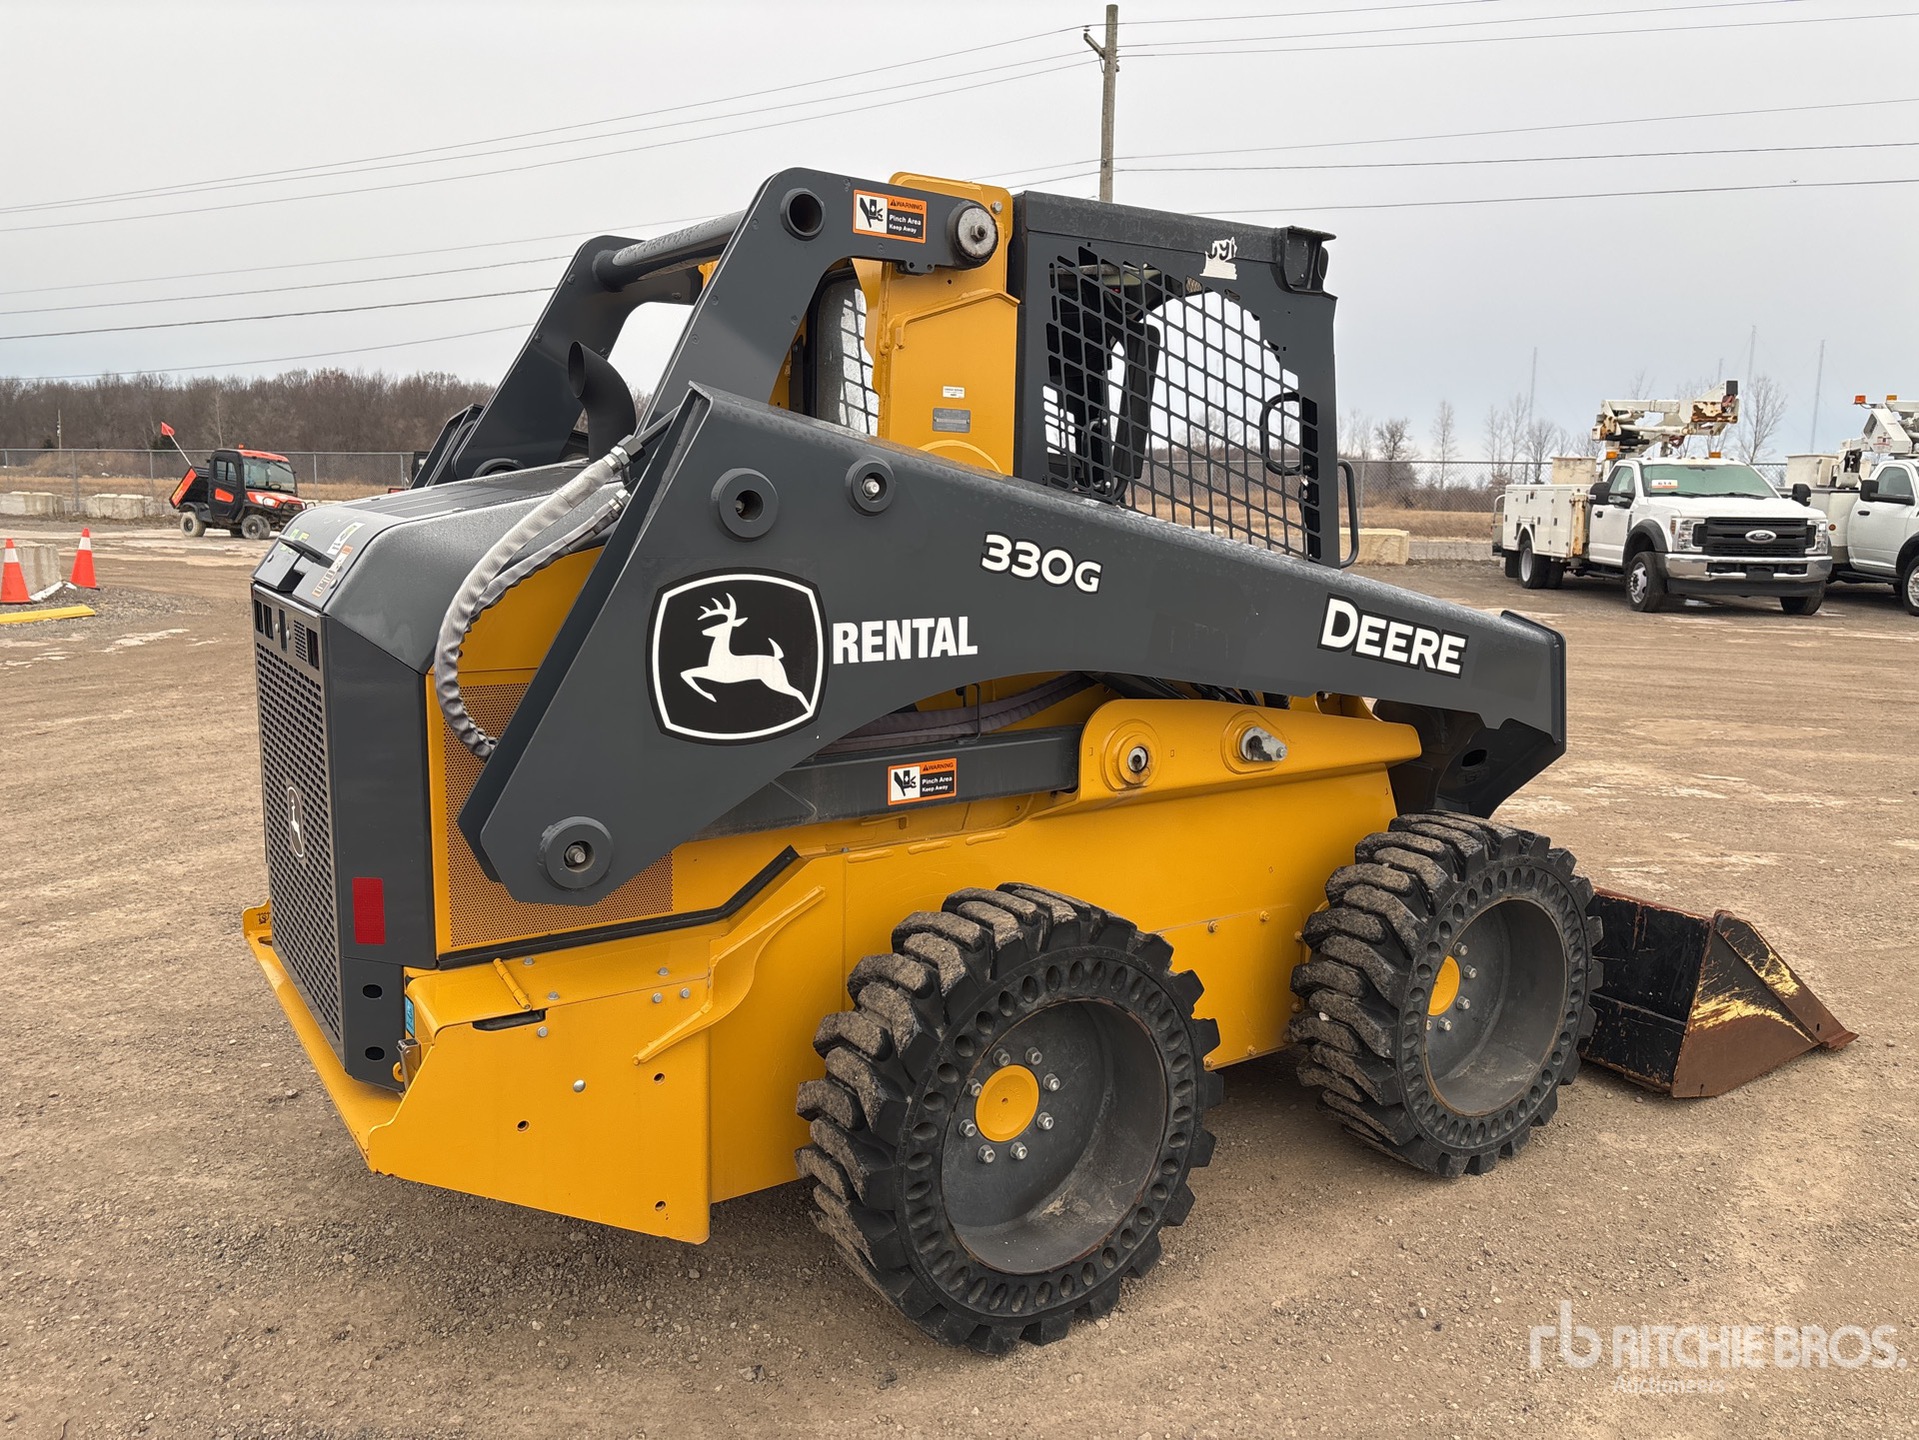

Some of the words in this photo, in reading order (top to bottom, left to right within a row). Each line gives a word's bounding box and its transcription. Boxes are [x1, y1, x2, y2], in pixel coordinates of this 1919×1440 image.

[889, 214, 906, 223] Pinch
[907, 217, 921, 226] Area
[897, 202, 922, 210] WARNING
[903, 225, 917, 234] Away
[981, 533, 1102, 593] 330G
[832, 615, 979, 665] RENTAL
[1320, 597, 1466, 675] DEERE
